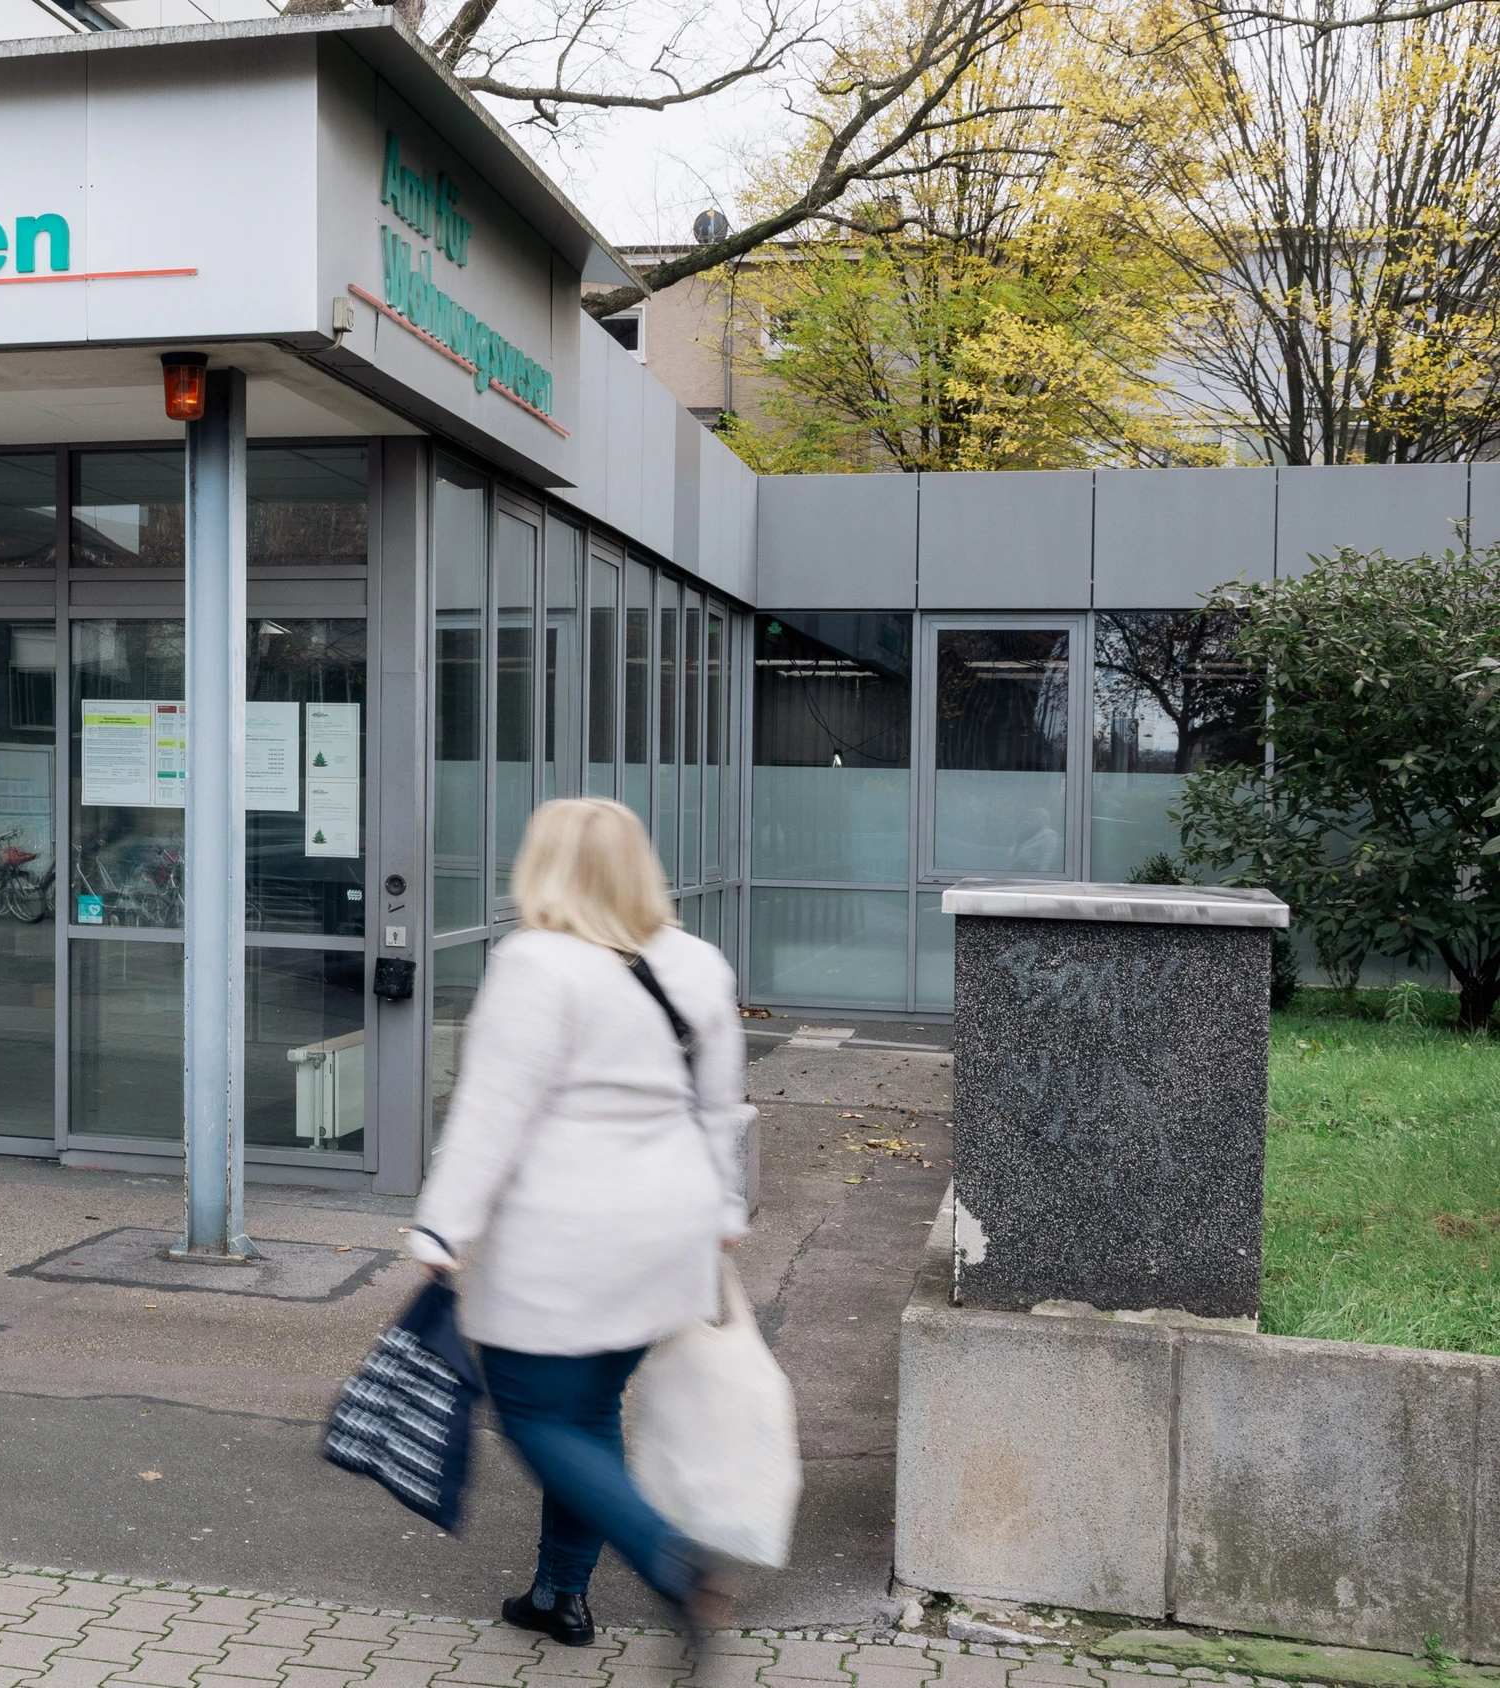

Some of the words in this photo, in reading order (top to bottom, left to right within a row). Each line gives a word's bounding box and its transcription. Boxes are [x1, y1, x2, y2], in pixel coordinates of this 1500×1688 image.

[381, 130, 433, 239] Amt
[435, 171, 473, 268] für
[381, 224, 553, 416] Wohnungswesen
